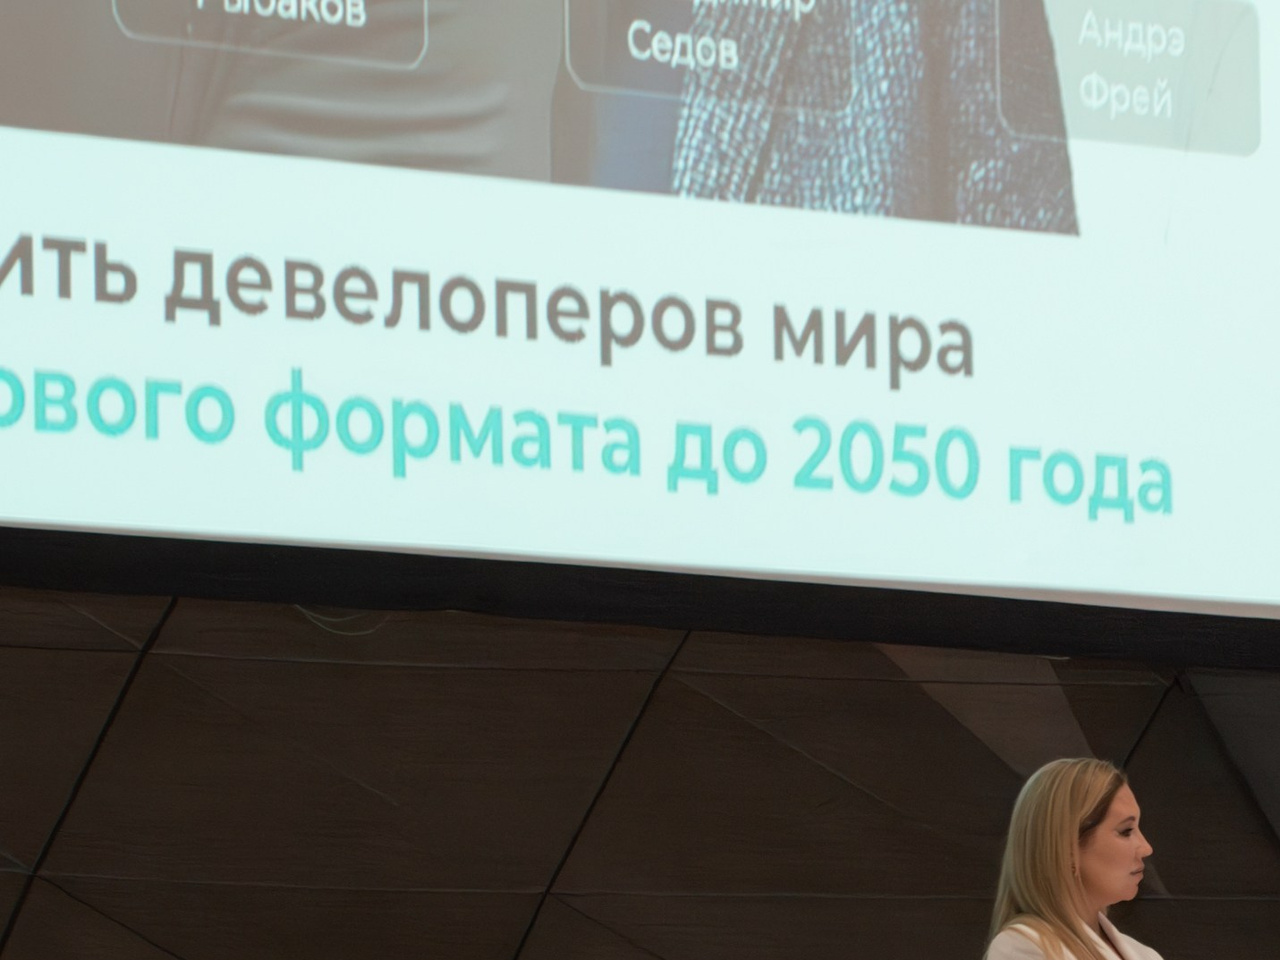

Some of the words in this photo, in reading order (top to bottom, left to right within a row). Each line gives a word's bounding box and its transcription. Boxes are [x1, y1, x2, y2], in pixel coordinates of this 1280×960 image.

[196, 0, 367, 28] аков
[1078, 9, 1185, 64] Андрэ
[627, 19, 739, 70] Седов
[1080, 70, 1172, 120] Фрей
[164, 247, 744, 367] девелоперов
[772, 301, 974, 391] мира
[264, 366, 642, 479] формата
[667, 420, 767, 496] до
[792, 415, 980, 500] 2050
[1008, 446, 1173, 524] года
